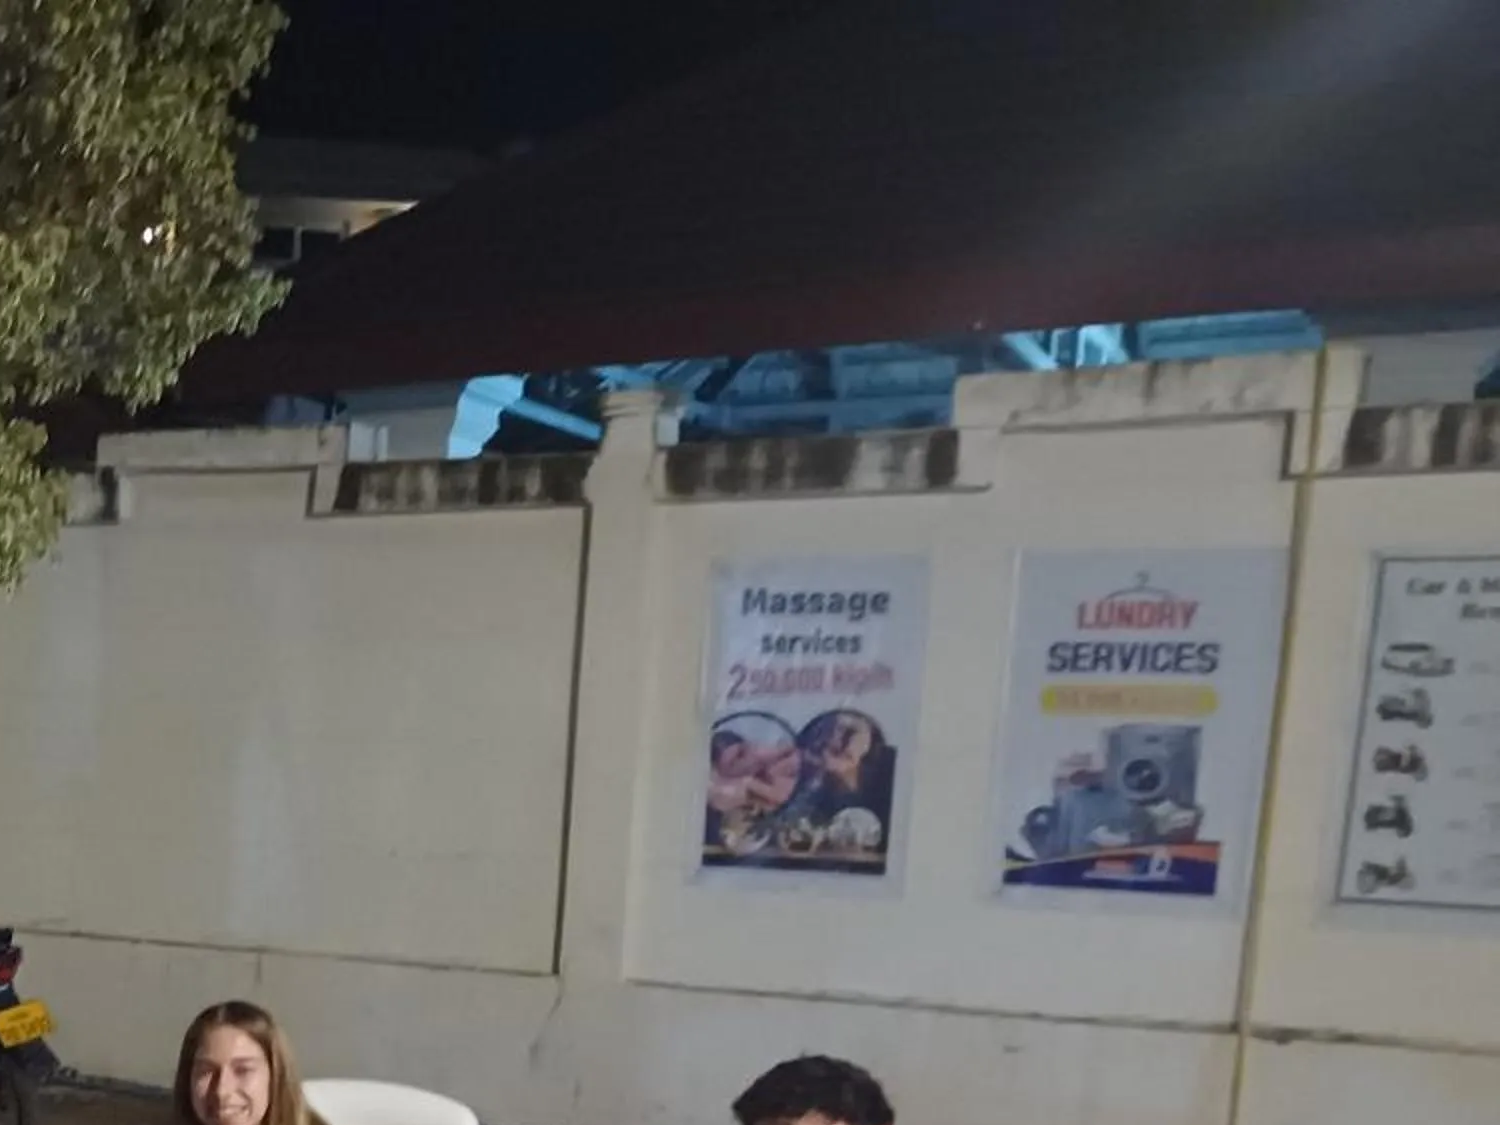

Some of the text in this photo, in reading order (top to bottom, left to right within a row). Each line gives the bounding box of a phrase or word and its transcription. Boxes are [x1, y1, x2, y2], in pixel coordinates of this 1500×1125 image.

[741, 587, 892, 622] Massage
[1075, 600, 1200, 631] LUNDRY
[760, 627, 864, 655] services
[1045, 642, 1222, 675] SERVICES
